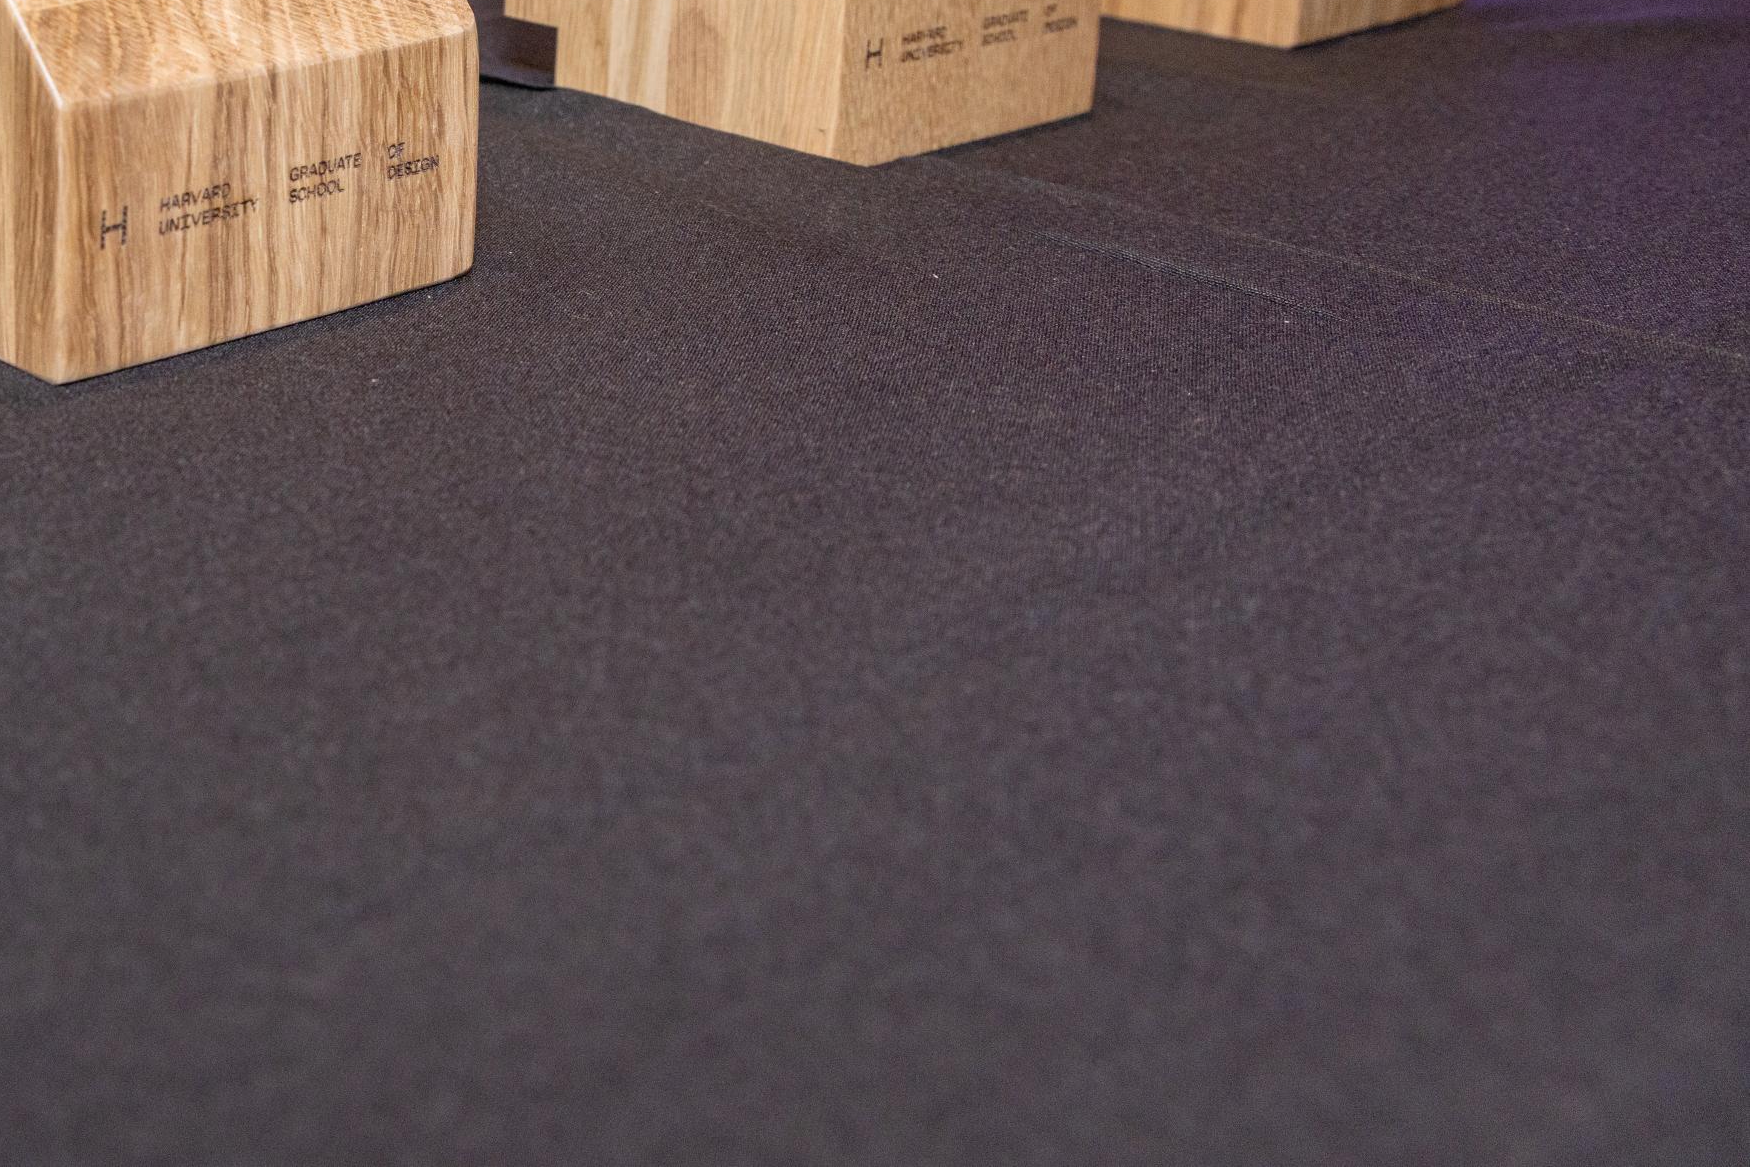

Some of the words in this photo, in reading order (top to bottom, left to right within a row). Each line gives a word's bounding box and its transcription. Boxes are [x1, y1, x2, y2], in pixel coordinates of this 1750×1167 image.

[386, 141, 407, 161] OF
[288, 152, 363, 183] GRADUATE
[386, 154, 441, 181] DESIGN
[159, 182, 232, 214] HARVARD
[288, 178, 346, 205] SCHOOL
[99, 204, 129, 251] H
[158, 197, 260, 236] UNIVERSITY
